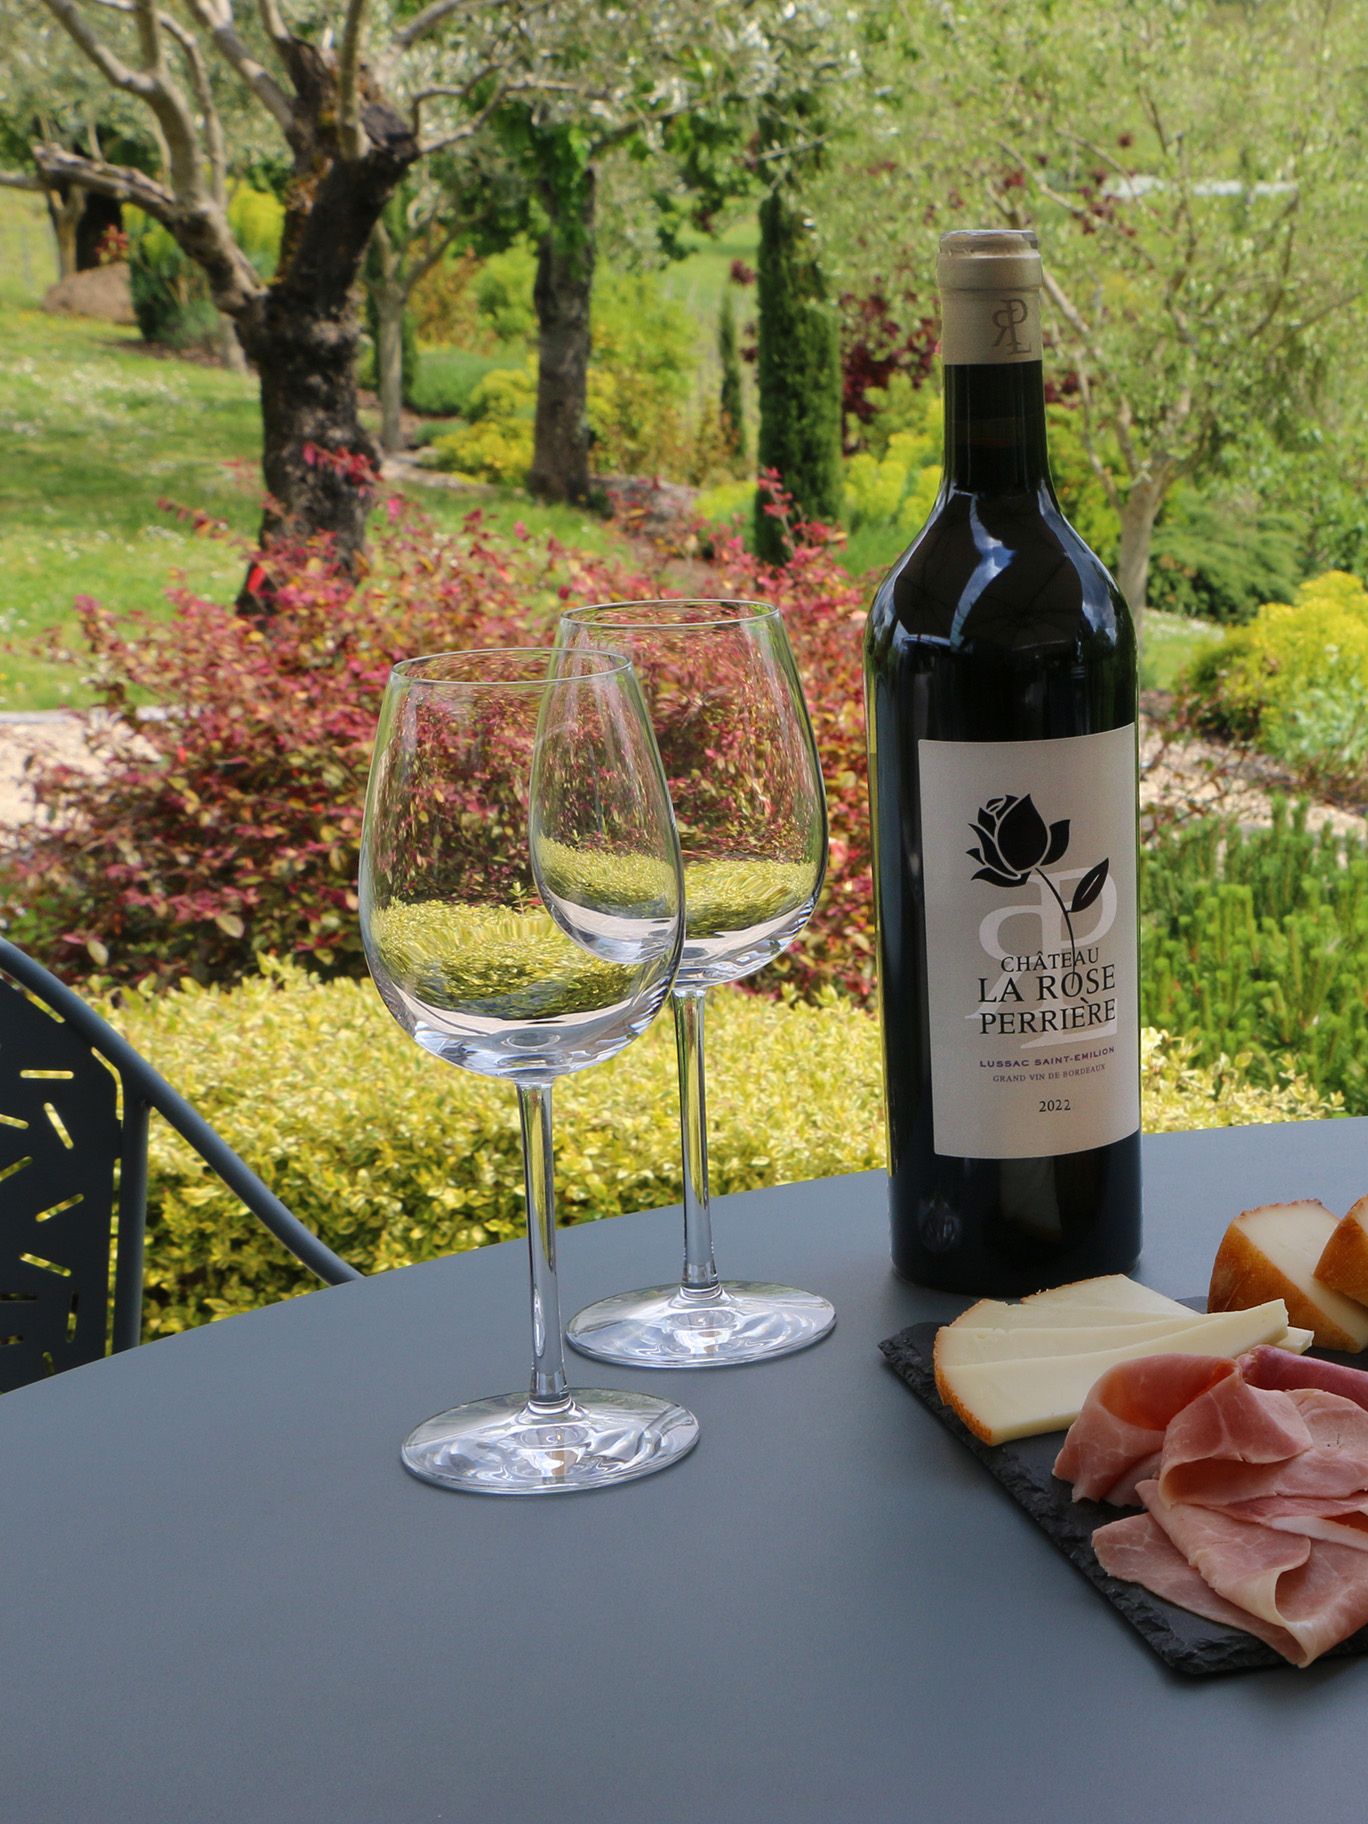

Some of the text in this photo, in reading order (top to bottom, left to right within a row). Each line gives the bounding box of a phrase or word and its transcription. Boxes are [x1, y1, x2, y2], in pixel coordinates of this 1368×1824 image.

[1001, 948, 1099, 972] CHÂTEAU
[978, 964, 1115, 1003] LA ROSE
[979, 997, 1116, 1034] PERRIÈRE
[979, 1046, 1115, 1068] LUSSAC SAINT-EMILION
[992, 1063, 1106, 1082] GRAND VIN DE BORDEAUX
[1039, 1099, 1071, 1112] 2022
